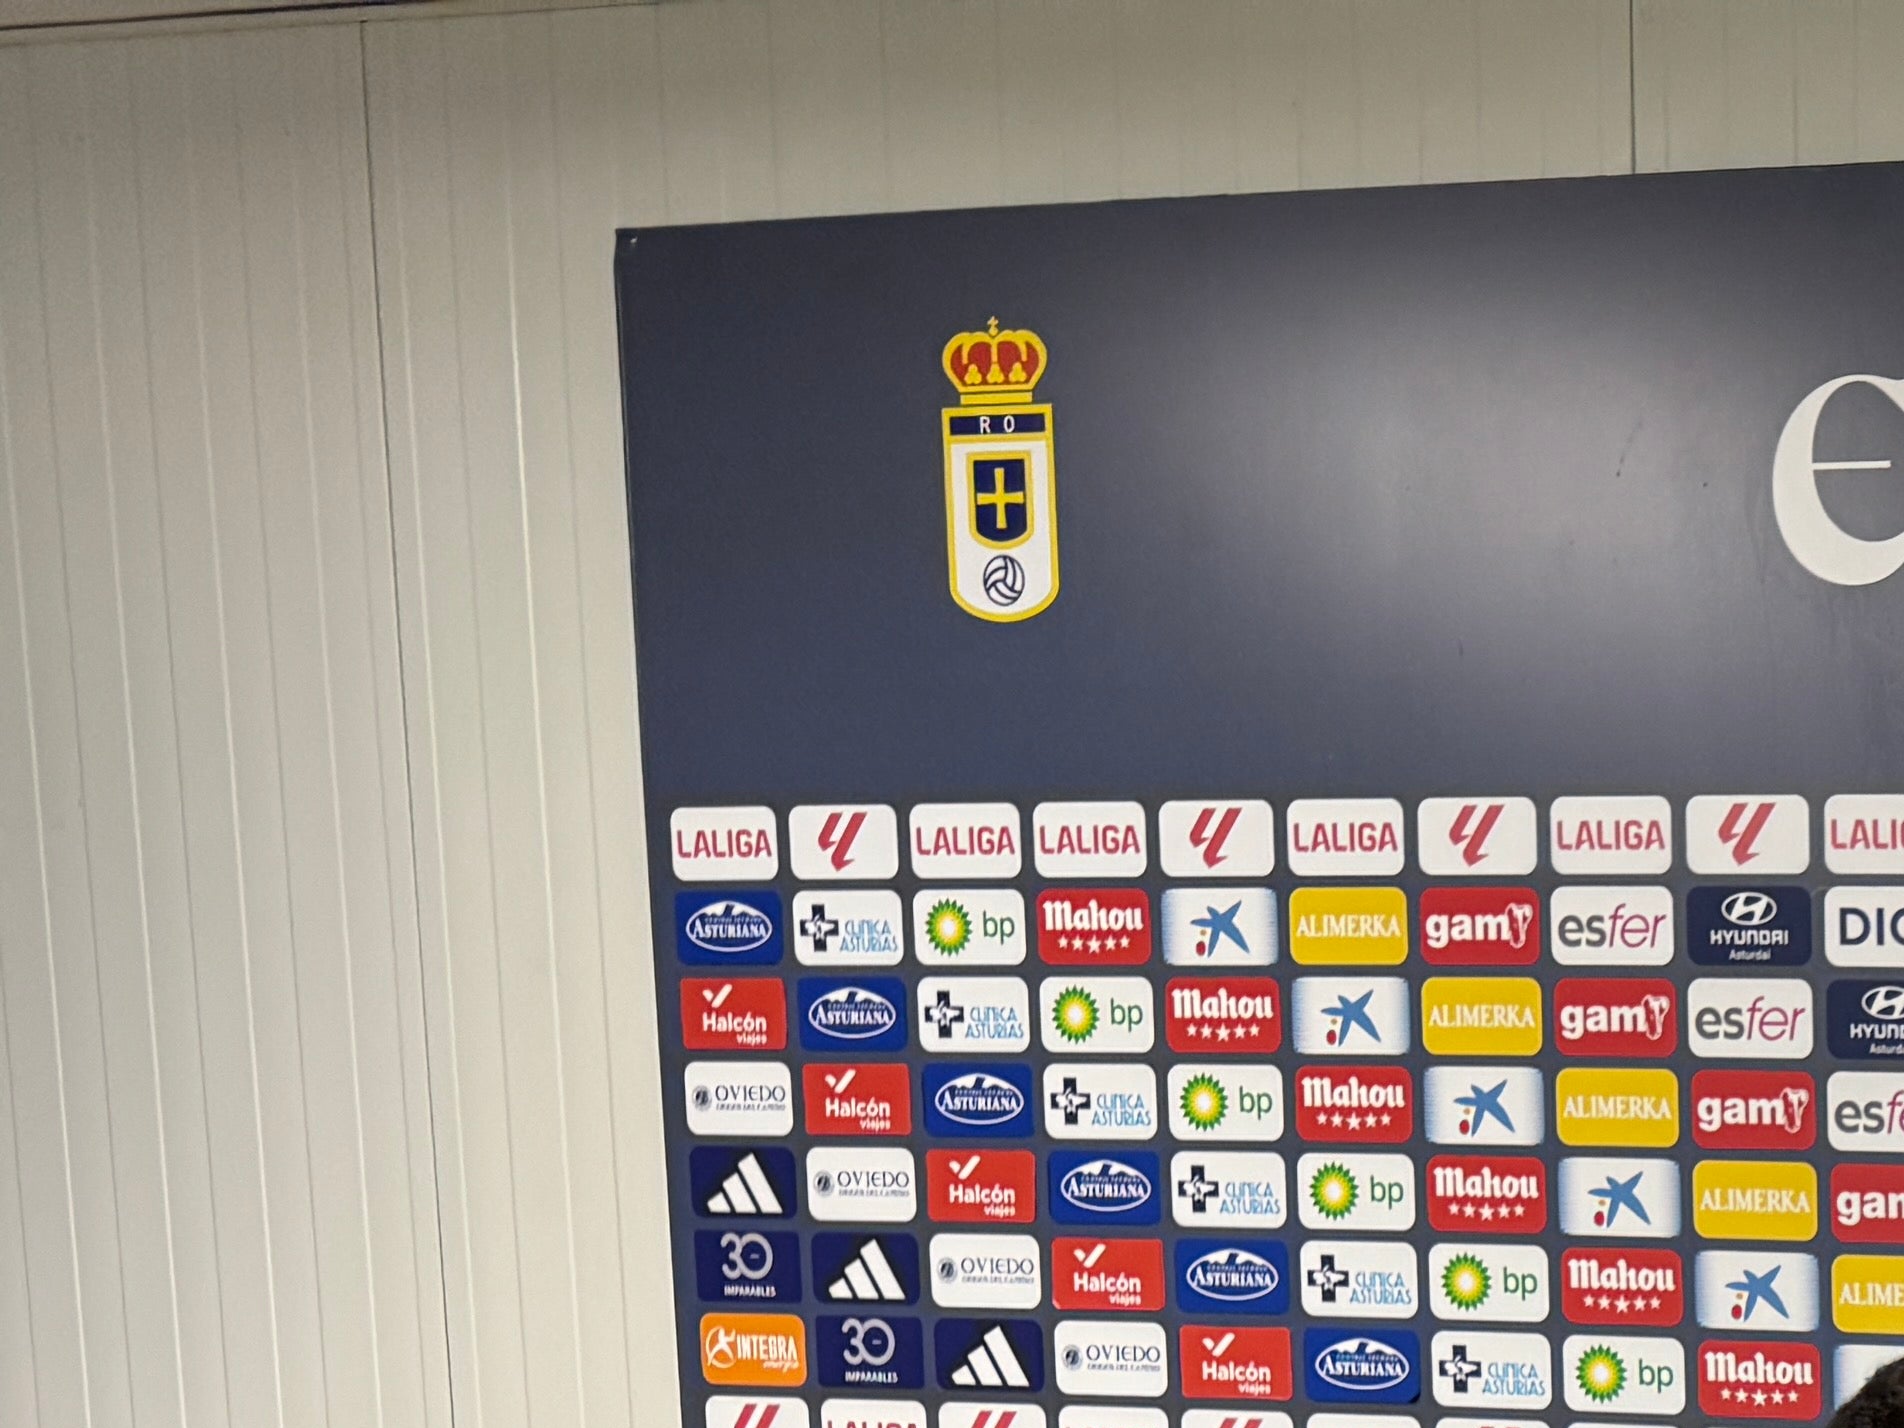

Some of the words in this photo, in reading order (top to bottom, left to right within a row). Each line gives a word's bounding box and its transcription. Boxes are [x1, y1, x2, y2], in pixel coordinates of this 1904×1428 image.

[676, 830, 771, 859] LALIGA
[916, 827, 1015, 856] LALIGA
[983, 911, 1014, 944] bp
[1043, 900, 1143, 930] Mahou
[1299, 916, 1399, 936] ALIMERKA
[1558, 904, 1666, 948] esfer
[703, 1011, 767, 1032] Halcón
[737, 1033, 767, 1045] viajes
[715, 1085, 786, 1102] OVIEDO
[1434, 1167, 1538, 1198] Mahou
